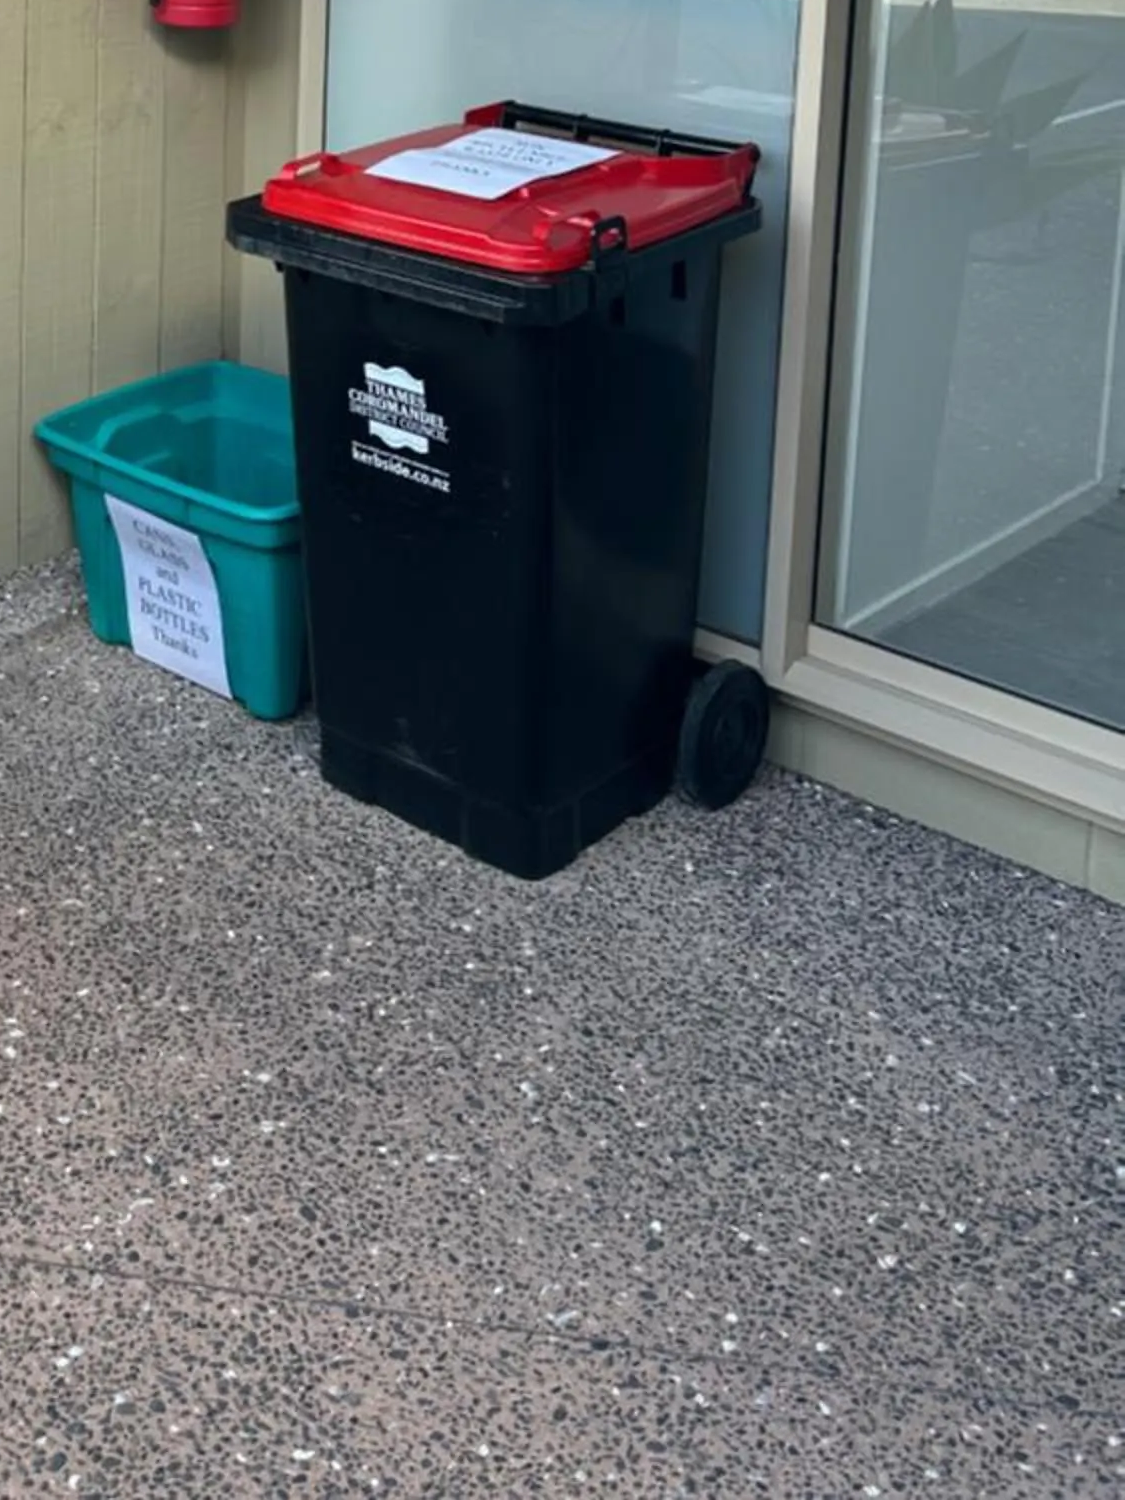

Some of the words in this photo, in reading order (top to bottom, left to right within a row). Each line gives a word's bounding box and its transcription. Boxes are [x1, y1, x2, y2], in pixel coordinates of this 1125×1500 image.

[348, 387, 448, 428] COROMANDEL
[366, 379, 427, 410] THAMES
[351, 444, 451, 493] kerbside.co.nz
[137, 575, 203, 617] PLASTIC
[140, 597, 211, 644] BOTTLES
[151, 624, 199, 660] Thanks
